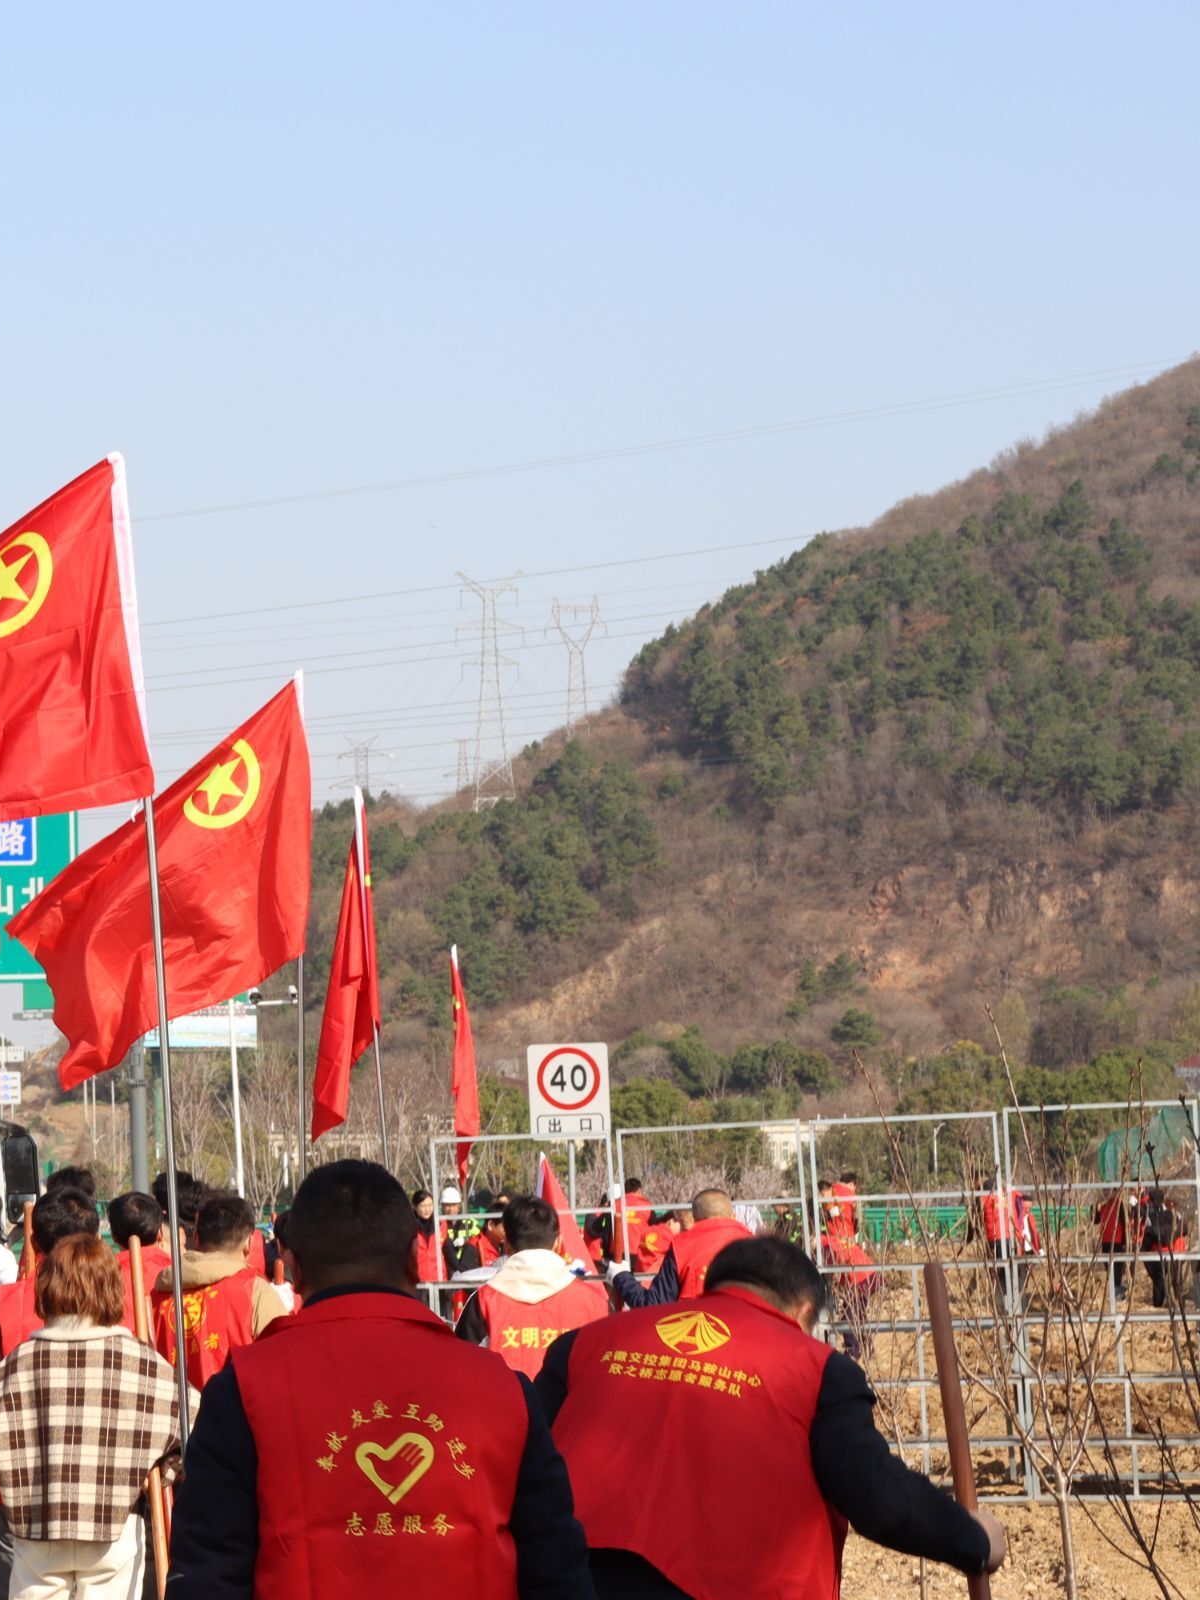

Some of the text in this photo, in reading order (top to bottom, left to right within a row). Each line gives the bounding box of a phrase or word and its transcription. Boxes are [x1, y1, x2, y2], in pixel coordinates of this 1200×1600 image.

[550, 1064, 587, 1092] 40
[548, 1118, 592, 1133] 出口
[502, 1327, 570, 1348] 文明交
[345, 1511, 455, 1537] 志愿服务
